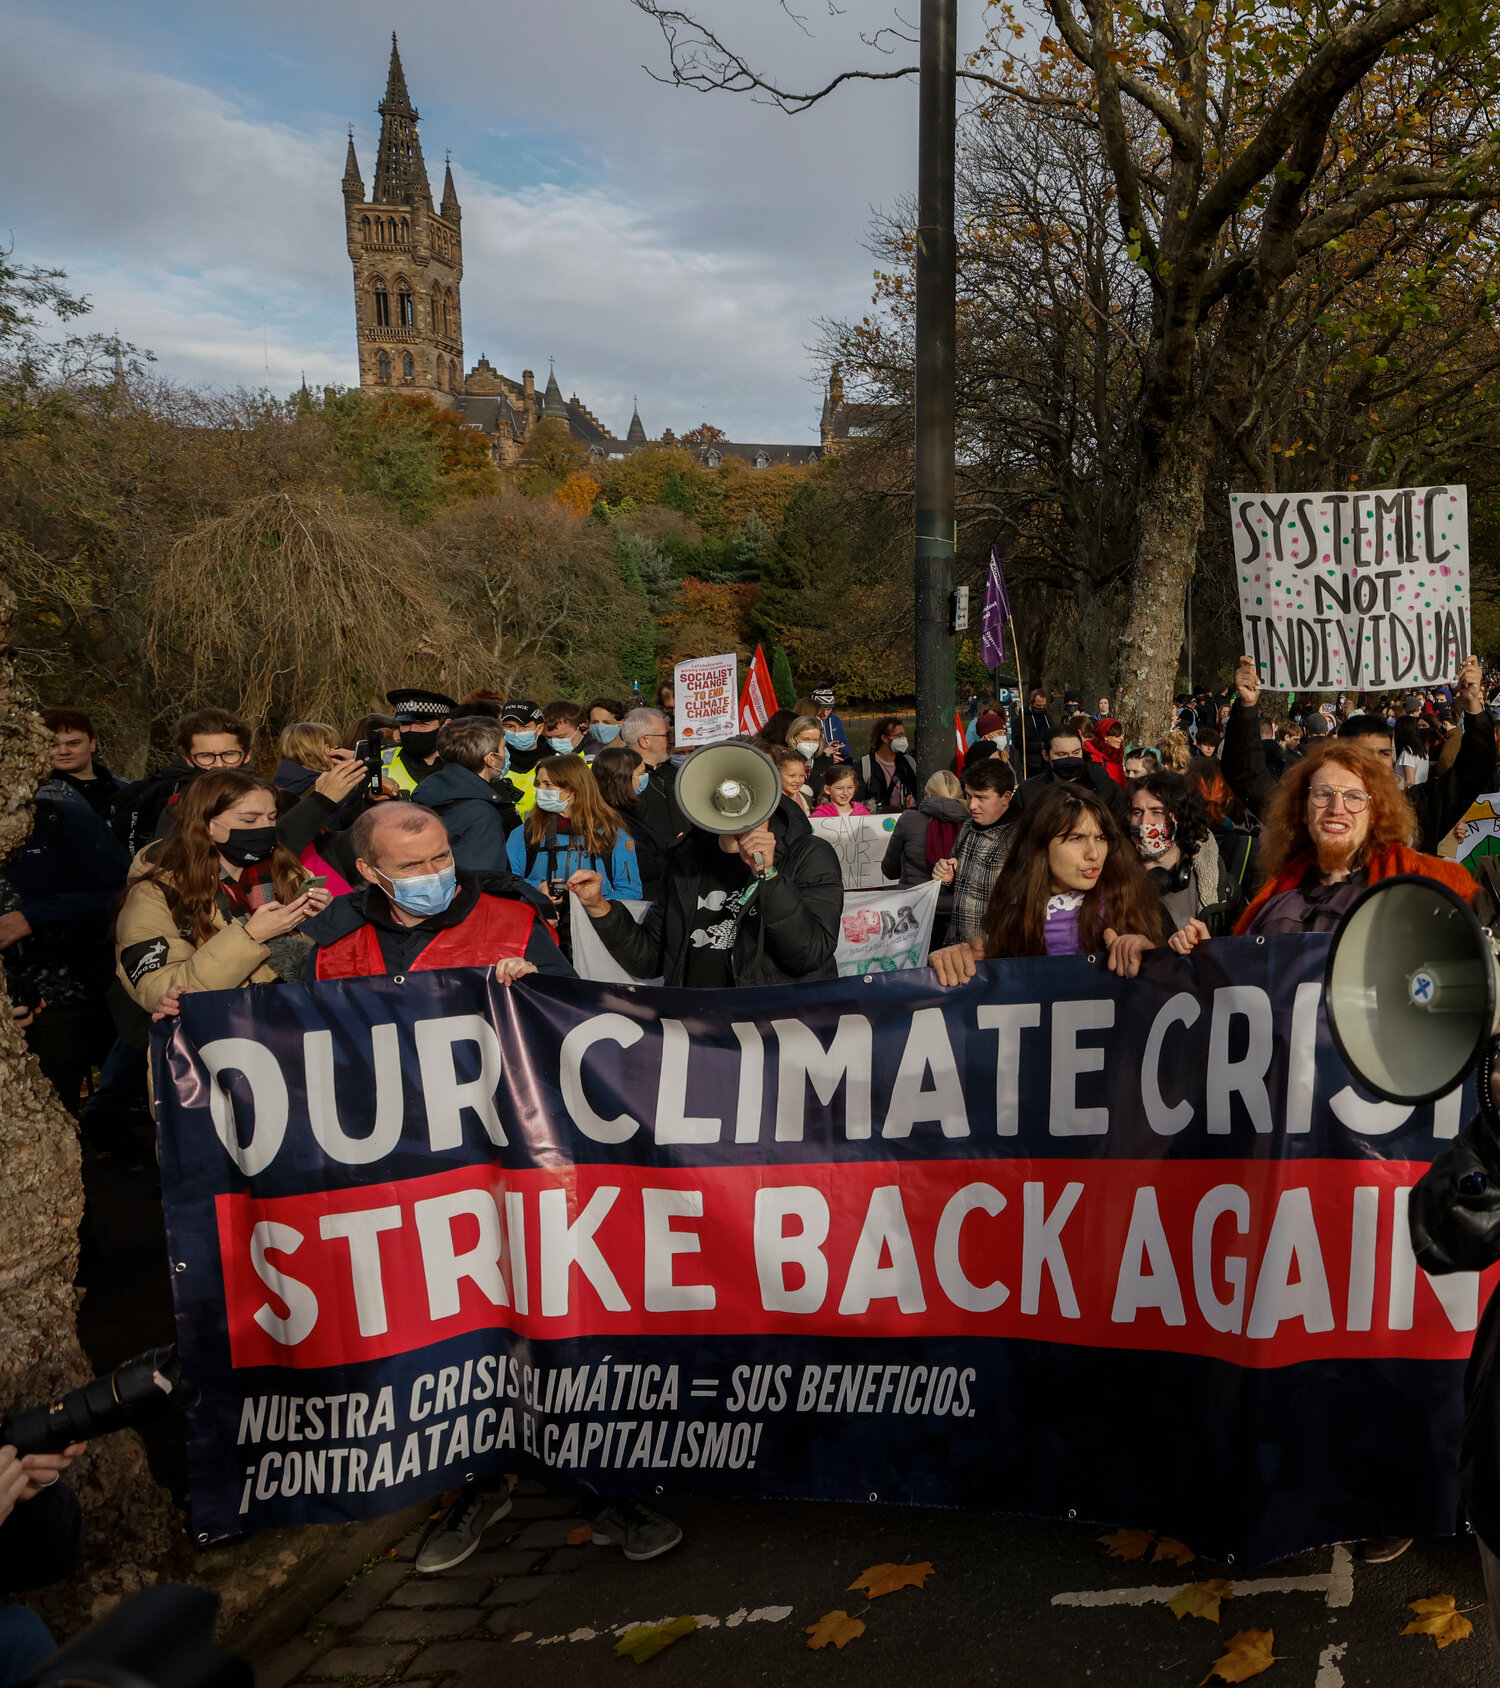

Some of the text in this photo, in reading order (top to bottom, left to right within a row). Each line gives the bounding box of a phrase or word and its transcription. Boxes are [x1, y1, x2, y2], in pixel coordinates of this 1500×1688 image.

[1239, 487, 1451, 569] SYSTEMIC
[1314, 569, 1402, 616] NOT
[680, 668, 733, 682] SOCIALIST
[687, 677, 728, 690] CHANGE
[685, 696, 729, 710] CLIMATE
[687, 705, 728, 718] CHANGE
[693, 687, 724, 701] TO END
[821, 816, 879, 844] SAVE
[198, 1012, 510, 1177] OUR
[560, 999, 1116, 1145] CLIMATE
[1140, 981, 1463, 1140] CRI
[251, 1186, 716, 1346] STRIKE
[753, 1182, 1087, 1319] BACK
[1111, 1182, 1480, 1341] AGAIN
[237, 1354, 977, 1445] NUESTRA CRISIS CLIMÁTICA = SUS BENEFICIOS.
[238, 1407, 764, 1515] ¡CONTRAATACA EL CAPITALISMO!
